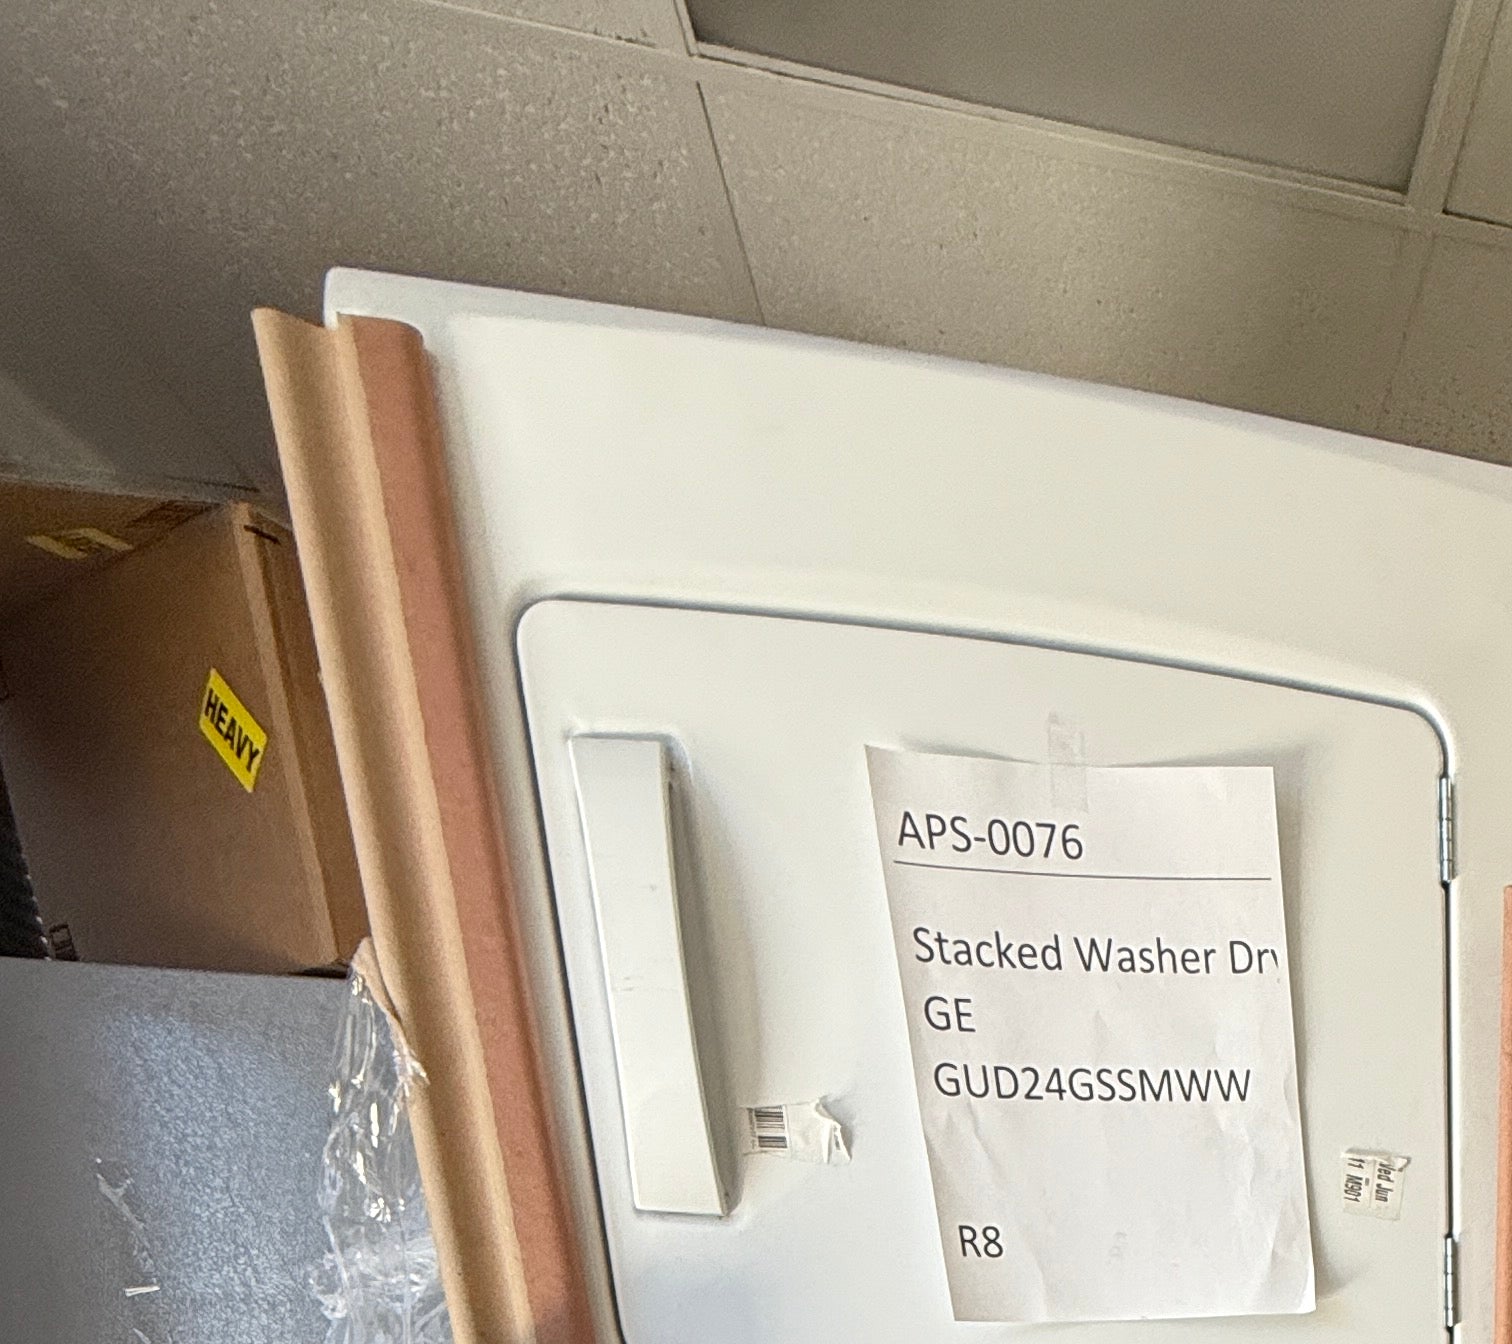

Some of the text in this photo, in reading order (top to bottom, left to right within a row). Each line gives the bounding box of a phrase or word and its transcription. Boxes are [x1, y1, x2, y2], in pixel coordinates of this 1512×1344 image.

[205, 688, 260, 773] HEAVY
[898, 810, 1084, 861] APS-0076
[912, 926, 1062, 971] Stacked
[1073, 936, 1217, 975] Washer
[923, 996, 977, 1033] GE
[933, 1062, 1251, 1102] GUD24GSSMWW
[958, 1225, 1004, 1259] R8
